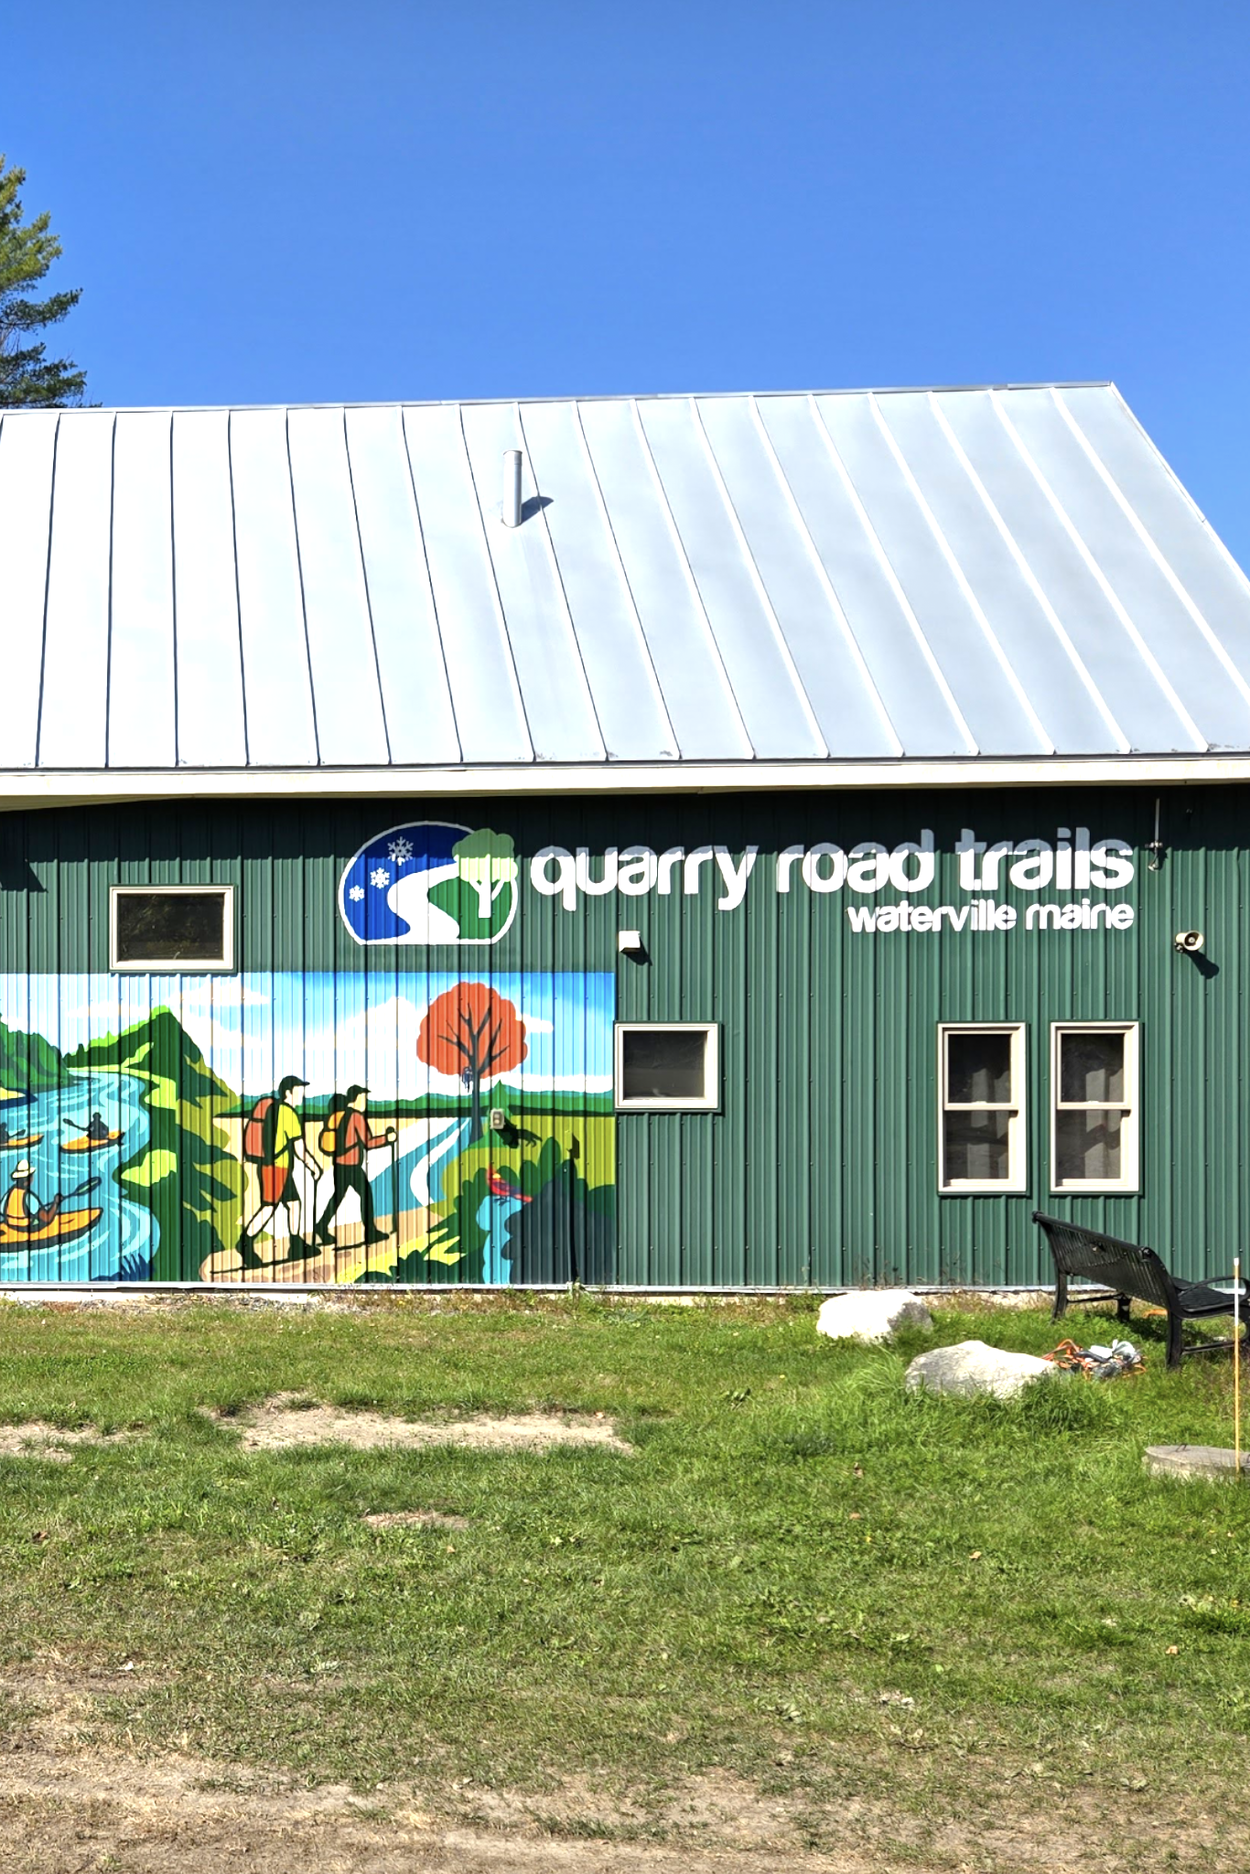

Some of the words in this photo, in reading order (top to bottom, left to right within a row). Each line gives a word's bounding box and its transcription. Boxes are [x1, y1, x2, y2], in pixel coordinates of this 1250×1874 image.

[530, 845, 759, 911] quarry
[776, 828, 935, 893] road
[955, 827, 1135, 891] trails
[847, 899, 1017, 932] waterville
[1025, 899, 1135, 930] maine
